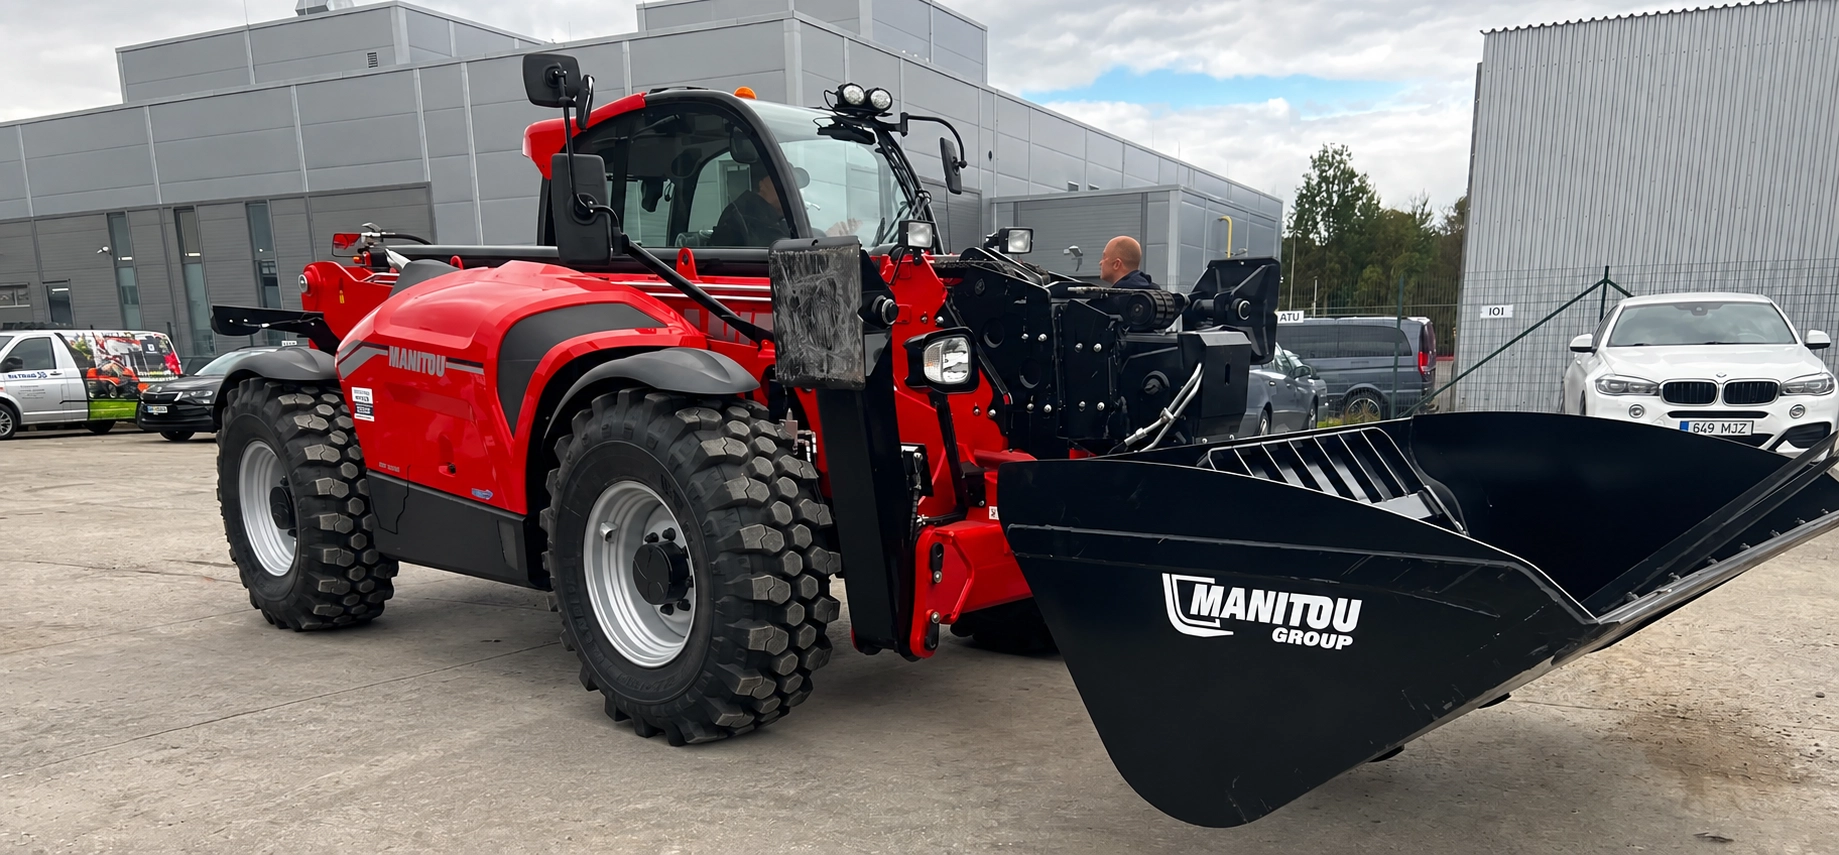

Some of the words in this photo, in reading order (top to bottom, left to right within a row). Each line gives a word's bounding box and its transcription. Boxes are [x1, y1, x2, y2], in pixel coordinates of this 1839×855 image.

[1280, 312, 1300, 322] ATU
[388, 345, 446, 377] MANITOU
[1693, 422, 1715, 434] 649
[1720, 423, 1747, 434] MJZ
[1189, 583, 1363, 633] MANITOU
[1271, 626, 1354, 650] GROUP
